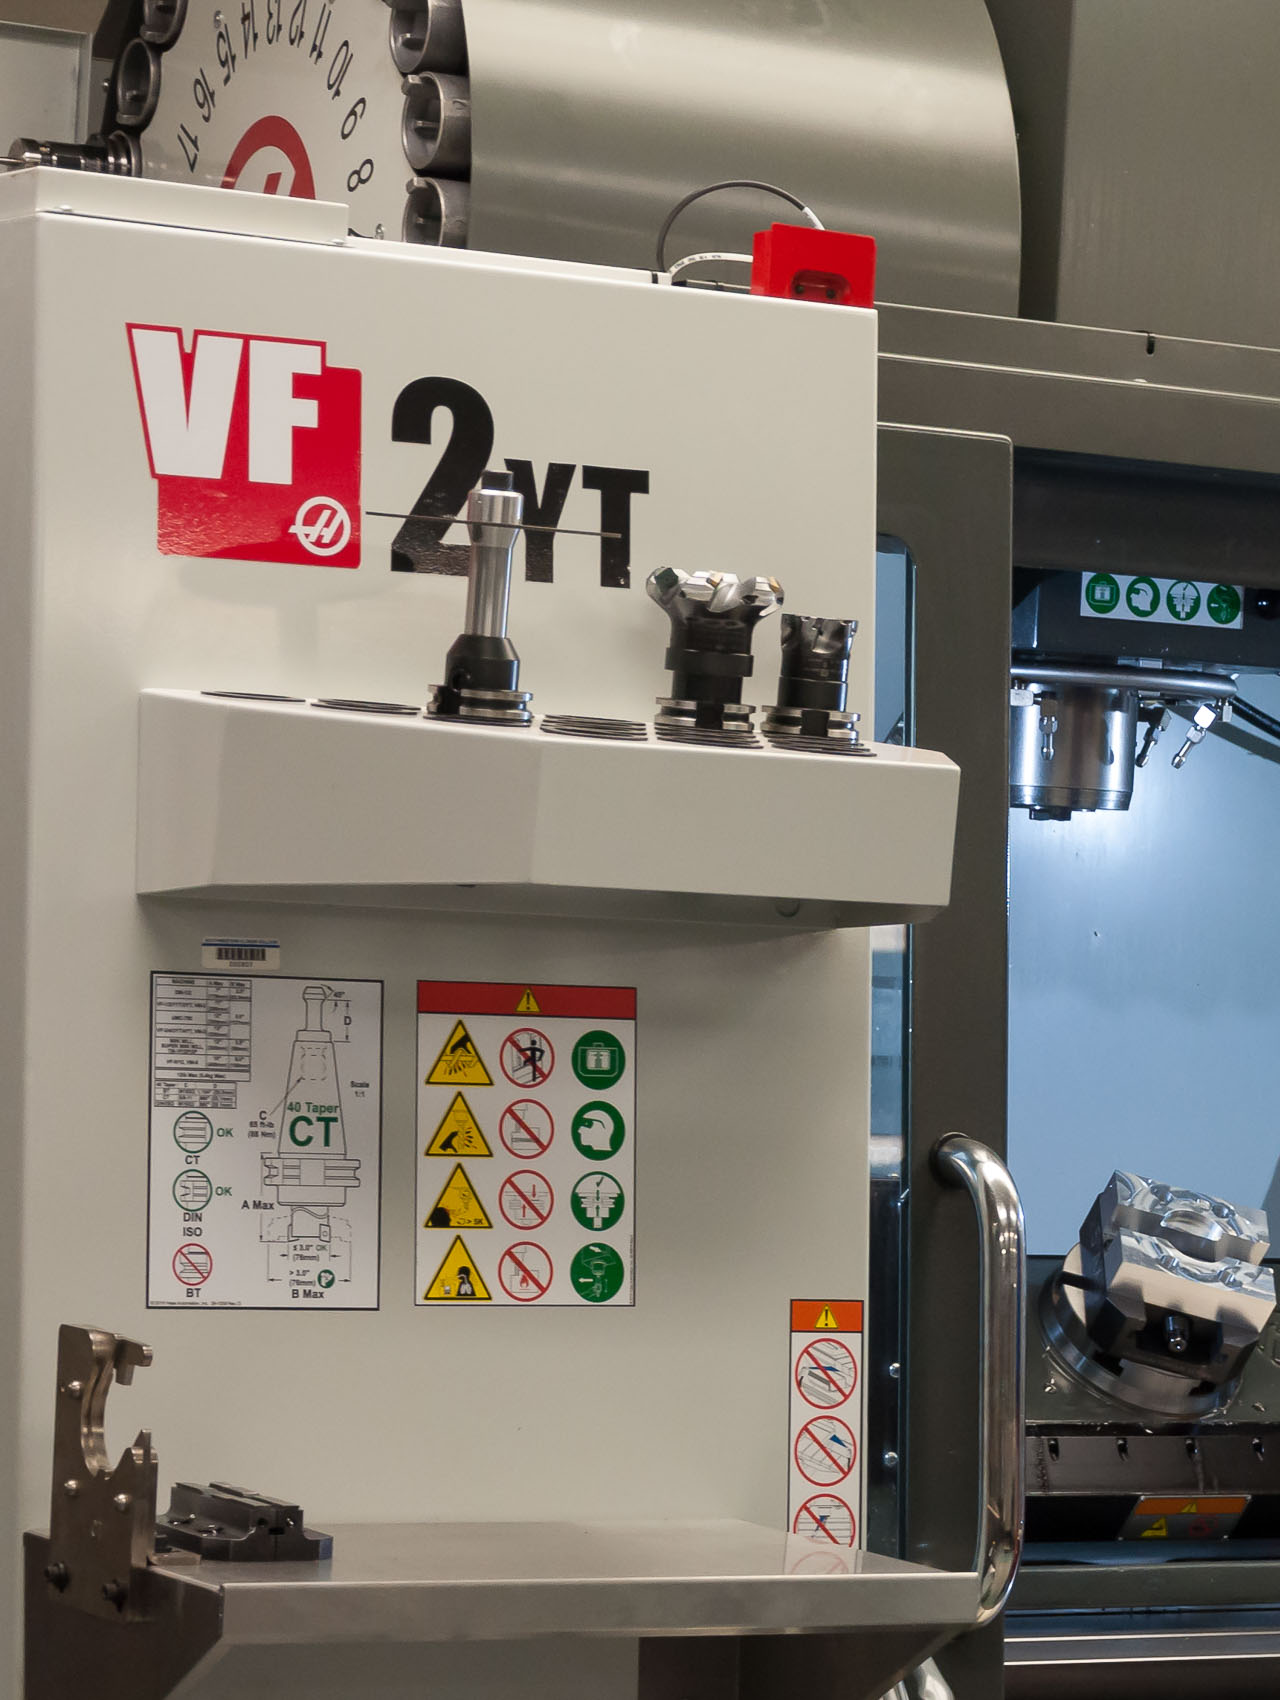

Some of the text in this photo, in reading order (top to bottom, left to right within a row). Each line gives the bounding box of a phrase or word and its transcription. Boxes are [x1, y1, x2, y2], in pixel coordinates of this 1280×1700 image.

[241, 2, 258, 59] 14
[309, 3, 331, 65] 11
[216, 23, 236, 87] 15
[327, 39, 354, 100] 10
[193, 67, 216, 123] 16
[177, 123, 200, 173] 17
[347, 158, 374, 193] 8
[131, 327, 322, 486] VF
[343, 1015, 352, 1026] D
[286, 1101, 340, 1116] 40 Taper
[258, 1110, 268, 1121] C
[216, 1127, 234, 1138] OK
[288, 1114, 340, 1148] CT
[184, 1154, 201, 1166] CT
[215, 1185, 233, 1197] OK
[240, 1199, 275, 1211] A Max
[182, 1212, 203, 1223] DIN
[182, 1226, 203, 1237] ISO
[185, 1287, 201, 1299] BT
[291, 1288, 325, 1299] B Max
